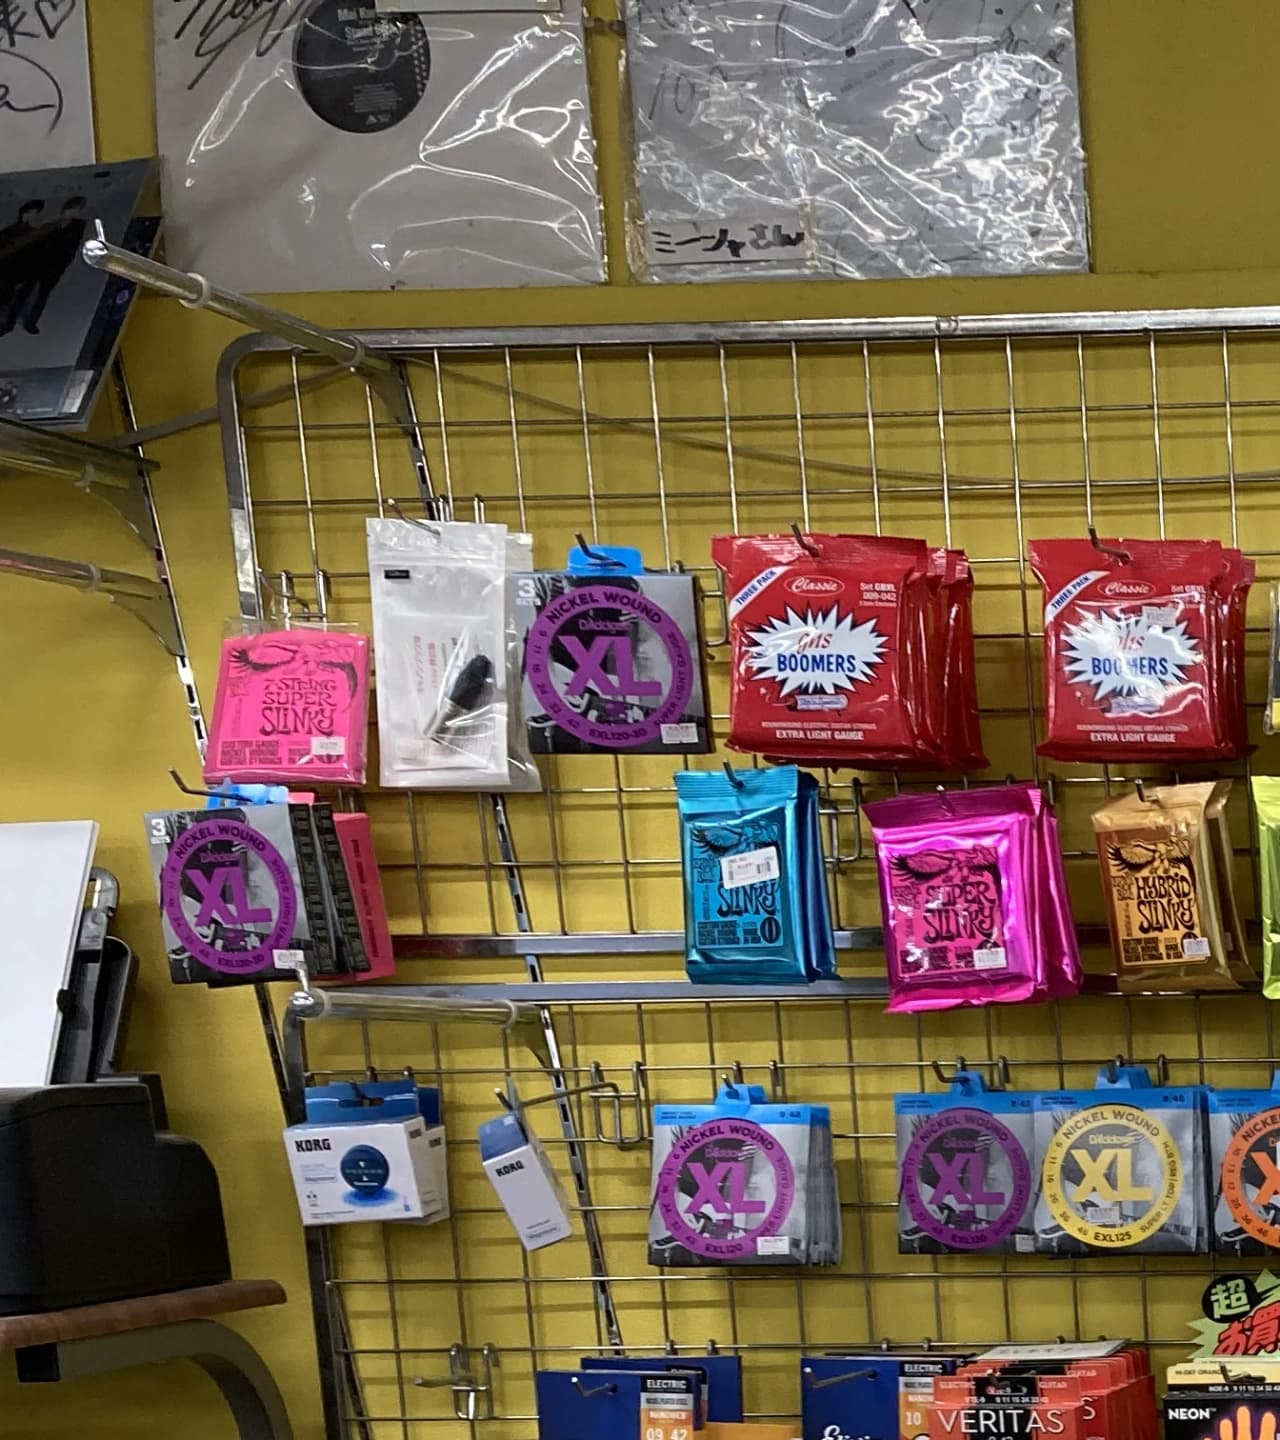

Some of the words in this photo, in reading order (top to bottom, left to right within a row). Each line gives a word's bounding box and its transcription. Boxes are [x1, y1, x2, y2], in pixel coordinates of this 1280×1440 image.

[565, 636, 662, 696] XL
[777, 653, 856, 673] BOOMERS
[262, 690, 333, 706] SUPER
[260, 707, 336, 736] SLINKY
[776, 730, 802, 740] EXTRA
[804, 730, 830, 740] LIGHT
[832, 730, 864, 741] GAUGE
[1136, 877, 1190, 902] HYBRID
[1137, 901, 1195, 931] SLINKY
[295, 1138, 331, 1152] KORG
[1094, 1230, 1132, 1243] EXL125
[1210, 1281, 1250, 1319] 超
[936, 1408, 1064, 1434] VERITAS
[1168, 1408, 1210, 1421] NEON
